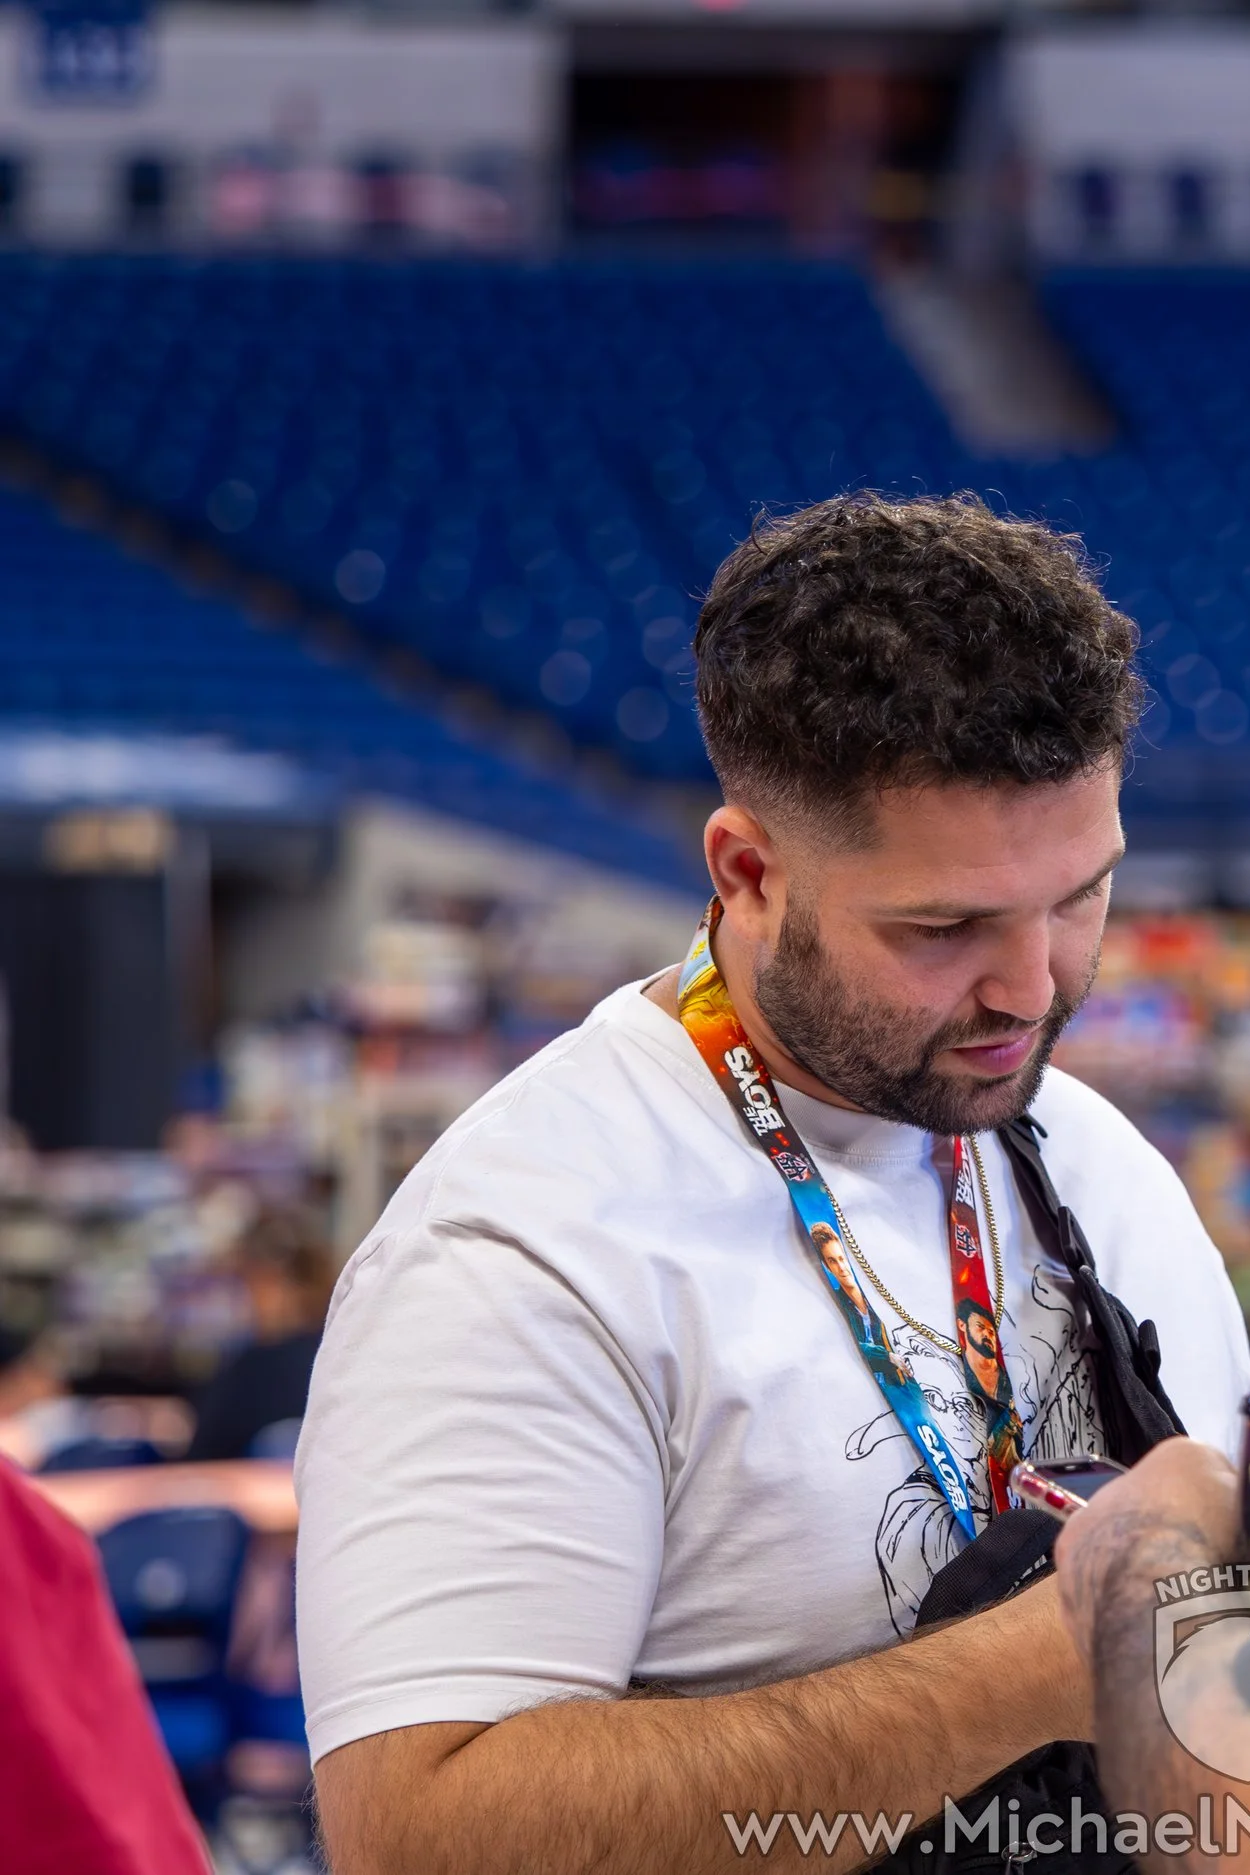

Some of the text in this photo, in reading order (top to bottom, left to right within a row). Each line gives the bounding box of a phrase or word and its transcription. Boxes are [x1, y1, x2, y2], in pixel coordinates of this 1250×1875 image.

[724, 1046, 785, 1130] BOYS
[743, 1106, 768, 1136] THE
[916, 1424, 969, 1511] BOYS
